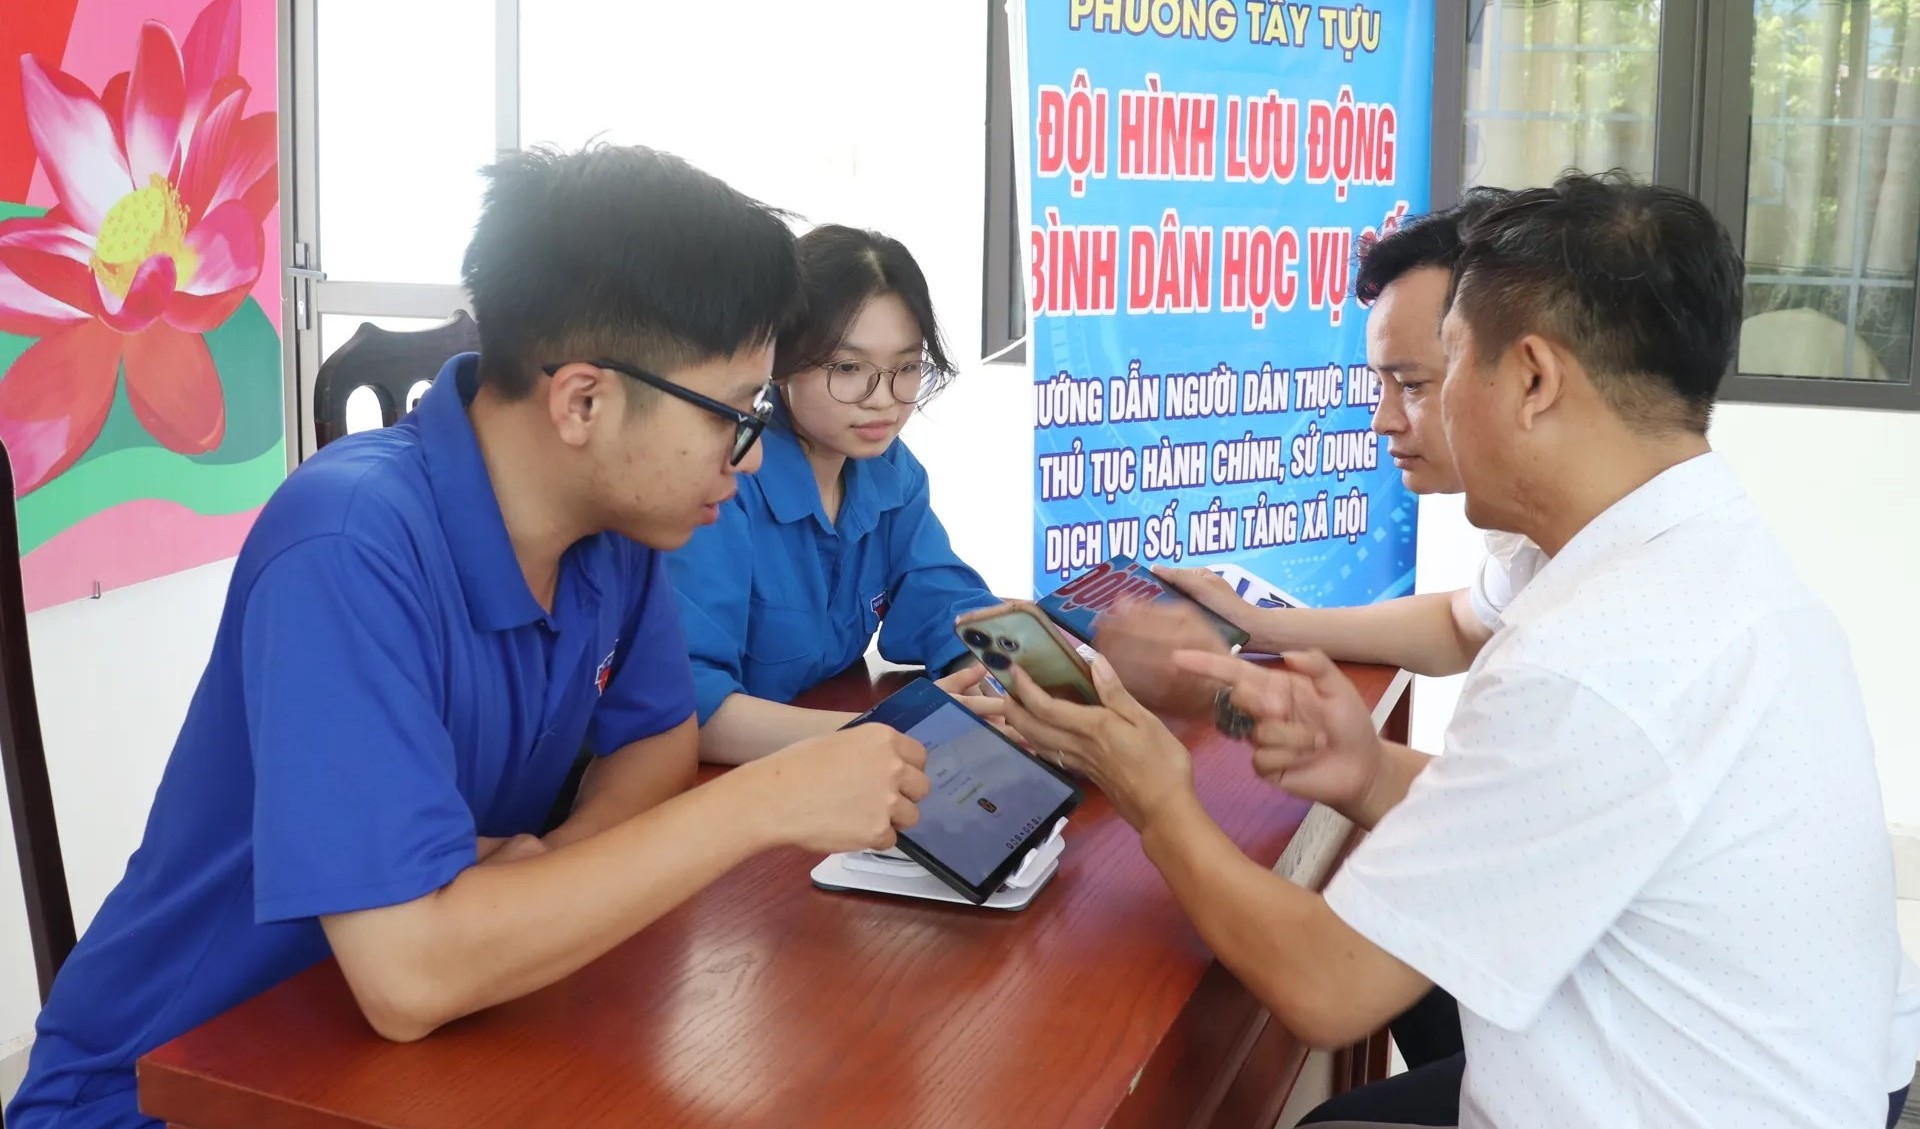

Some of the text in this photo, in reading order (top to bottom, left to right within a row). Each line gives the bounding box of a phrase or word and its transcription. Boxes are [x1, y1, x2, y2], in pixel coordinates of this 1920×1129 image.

[1319, 4, 1381, 61] TỰU
[1038, 72, 1396, 199] ĐỘI HÌNH LƯU ĐỘNG
[1128, 211, 1212, 310] DÂN
[1222, 229, 1298, 326] HỌC
[1308, 230, 1351, 323] VỤ
[1108, 361, 1160, 421] DẪN
[1165, 363, 1238, 417] NGƯỜI
[1243, 363, 1289, 413] DÂN
[1294, 363, 1343, 416] THỰC
[1040, 422, 1378, 502] THỦ TỤC HÀNH CHÍNH, SỬ DỤNG
[1046, 522, 1102, 579] DỊCH
[1144, 500, 1182, 562] SỐ,
[1189, 497, 1237, 555] NỀN
[1243, 492, 1297, 547] TẢNG
[1301, 491, 1328, 541] XÃ
[1333, 487, 1368, 543] HỘI
